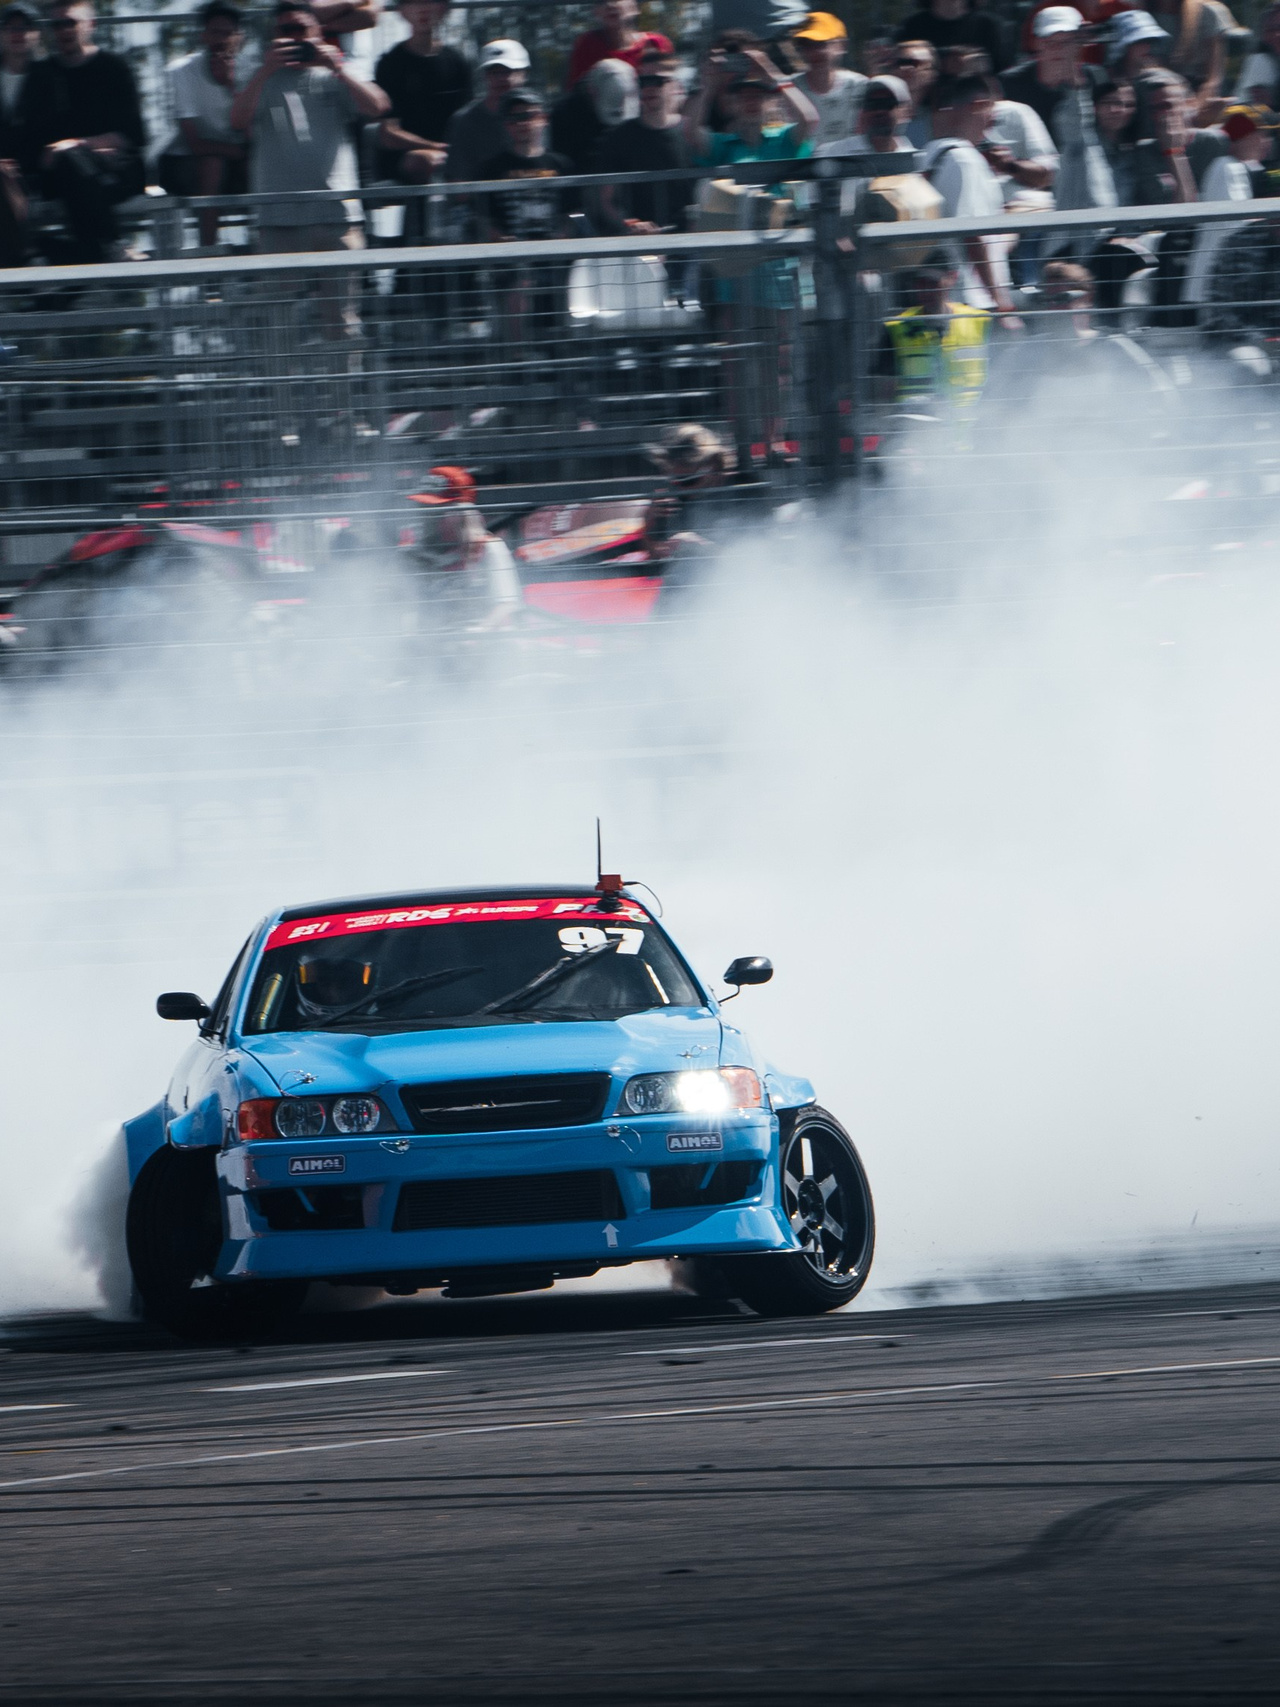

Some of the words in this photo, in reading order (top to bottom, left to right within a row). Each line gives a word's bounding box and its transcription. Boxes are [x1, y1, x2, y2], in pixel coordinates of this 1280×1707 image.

[386, 907, 455, 924] RDS
[558, 926, 645, 955] 97
[669, 1136, 720, 1148] AIMOL
[291, 1158, 343, 1171] AIMOL
